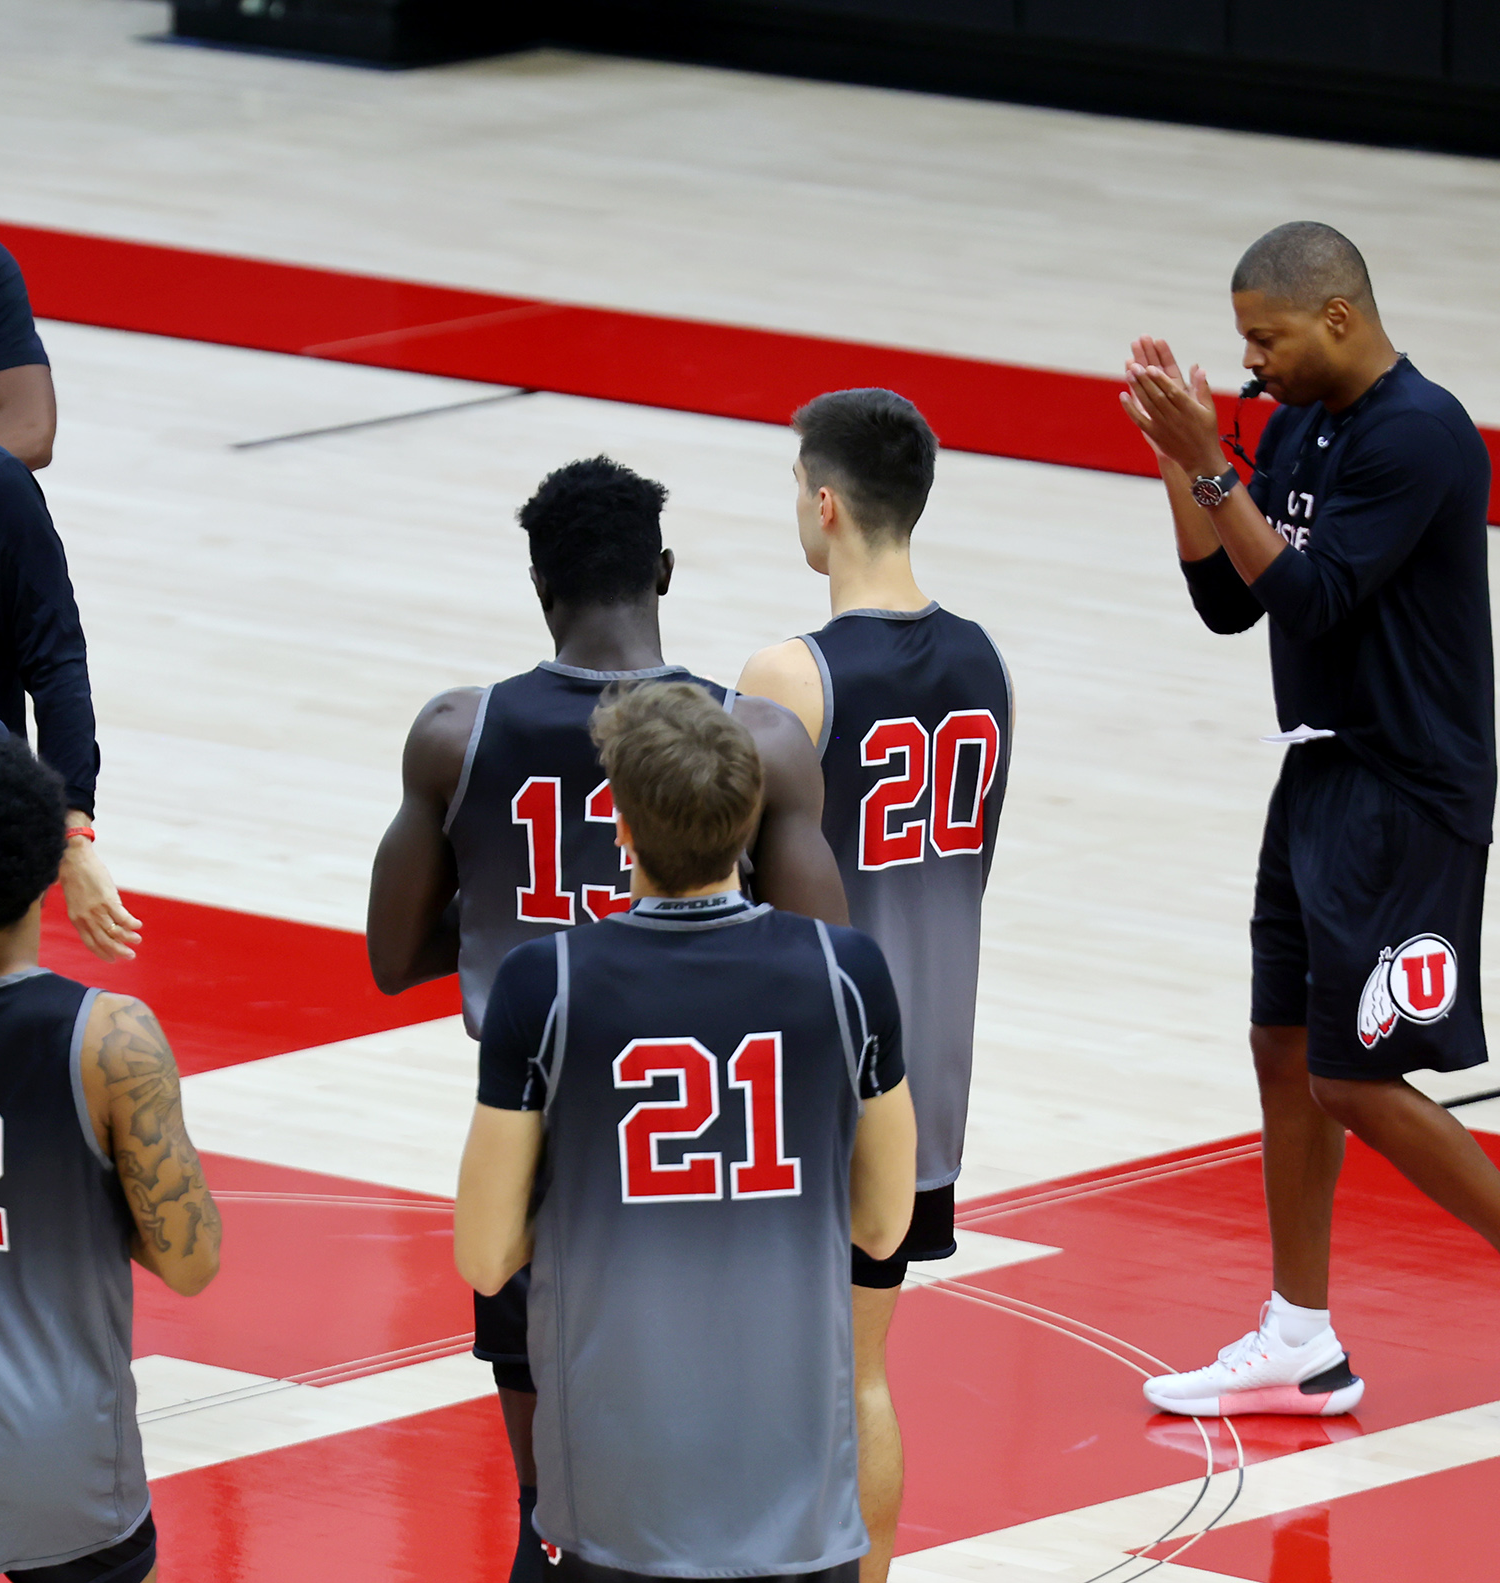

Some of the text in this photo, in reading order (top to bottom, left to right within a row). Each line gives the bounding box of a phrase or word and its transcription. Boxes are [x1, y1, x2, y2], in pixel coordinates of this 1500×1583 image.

[858, 709, 1000, 871] 20
[654, 896, 727, 910] ARMOUR
[1401, 951, 1447, 1011] U
[612, 1031, 802, 1203] 21
